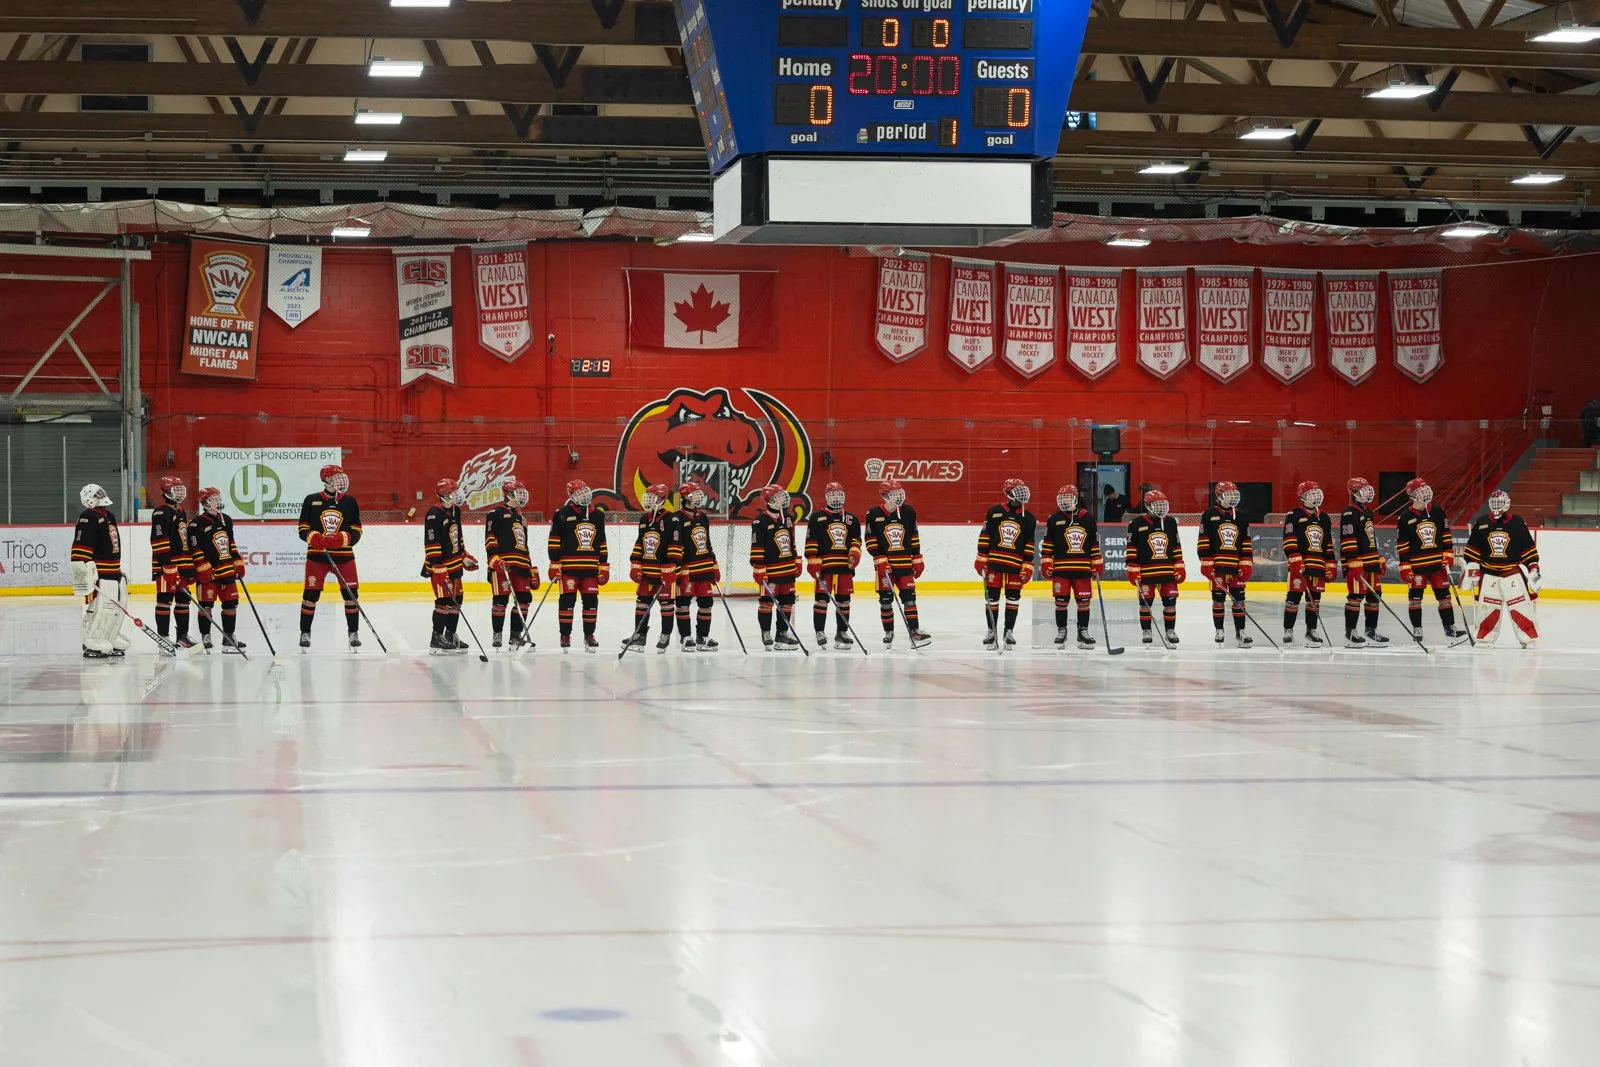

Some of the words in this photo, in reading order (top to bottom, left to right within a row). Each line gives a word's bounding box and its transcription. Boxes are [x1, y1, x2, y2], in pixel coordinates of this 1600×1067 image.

[882, 18, 899, 47] 0
[932, 19, 949, 48] 0
[779, 58, 831, 76] Home
[849, 54, 960, 95] 20:00
[977, 60, 1029, 79] Guests
[810, 85, 832, 125] 0
[1008, 88, 1030, 127] 0
[790, 132, 817, 144] goal
[876, 123, 926, 142] period
[951, 120, 958, 145] 1
[987, 135, 1013, 146] goal
[209, 269, 244, 289] NW
[403, 259, 447, 281] CIS
[480, 265, 524, 283] CANADA
[883, 271, 923, 289] CANADA
[482, 283, 524, 307] WEST
[882, 288, 923, 313] WEST
[1009, 286, 1051, 303] CANADA
[1071, 290, 1115, 305] CANADA
[1143, 290, 1181, 305] CANADA
[1202, 290, 1247, 305] CANADA
[1267, 292, 1310, 308] CANADA
[1330, 293, 1373, 309] CANADA
[1395, 292, 1439, 308] CANADA
[420, 299, 438, 309] HOCKEY
[957, 298, 988, 322] WEST
[190, 316, 218, 328] HOME
[220, 319, 232, 329] OF
[236, 320, 254, 331] THE
[481, 309, 528, 322] CHAMPIONS
[1010, 304, 1051, 327] WEST
[1072, 306, 1115, 328] WEST
[1144, 306, 1181, 328] WEST
[1202, 307, 1248, 329] WEST
[1268, 309, 1310, 332] WEST
[1332, 311, 1375, 332] WEST
[1397, 309, 1437, 331] WEST
[404, 318, 448, 337] CHAMPIONS
[493, 324, 520, 332] WOMEN'S
[951, 323, 991, 335] CHAMPINS
[1008, 331, 1052, 340] HAMPIONS
[1071, 332, 1115, 341] HAMPIONS
[1140, 331, 1185, 341] CHAMPIONS
[192, 329, 248, 348] NWCAA
[893, 334, 915, 342] HOCKEY
[1201, 333, 1247, 343] CHAMPIONS
[1330, 335, 1374, 345] CHAMPIONS
[1396, 333, 1440, 344] CHAMPIONS
[190, 346, 227, 359] MIDGET
[229, 350, 249, 360] AAA
[406, 345, 449, 366] SIC
[199, 358, 238, 370] FLAMES
[205, 451, 251, 460] PROUDLY
[254, 451, 317, 460] SPONSORED
[320, 451, 336, 460] BY:
[881, 460, 963, 481] FLAMES
[469, 487, 501, 508] FIR
[845, 515, 853, 525] C
[2, 540, 47, 559] Trico
[12, 561, 59, 574] Homes
